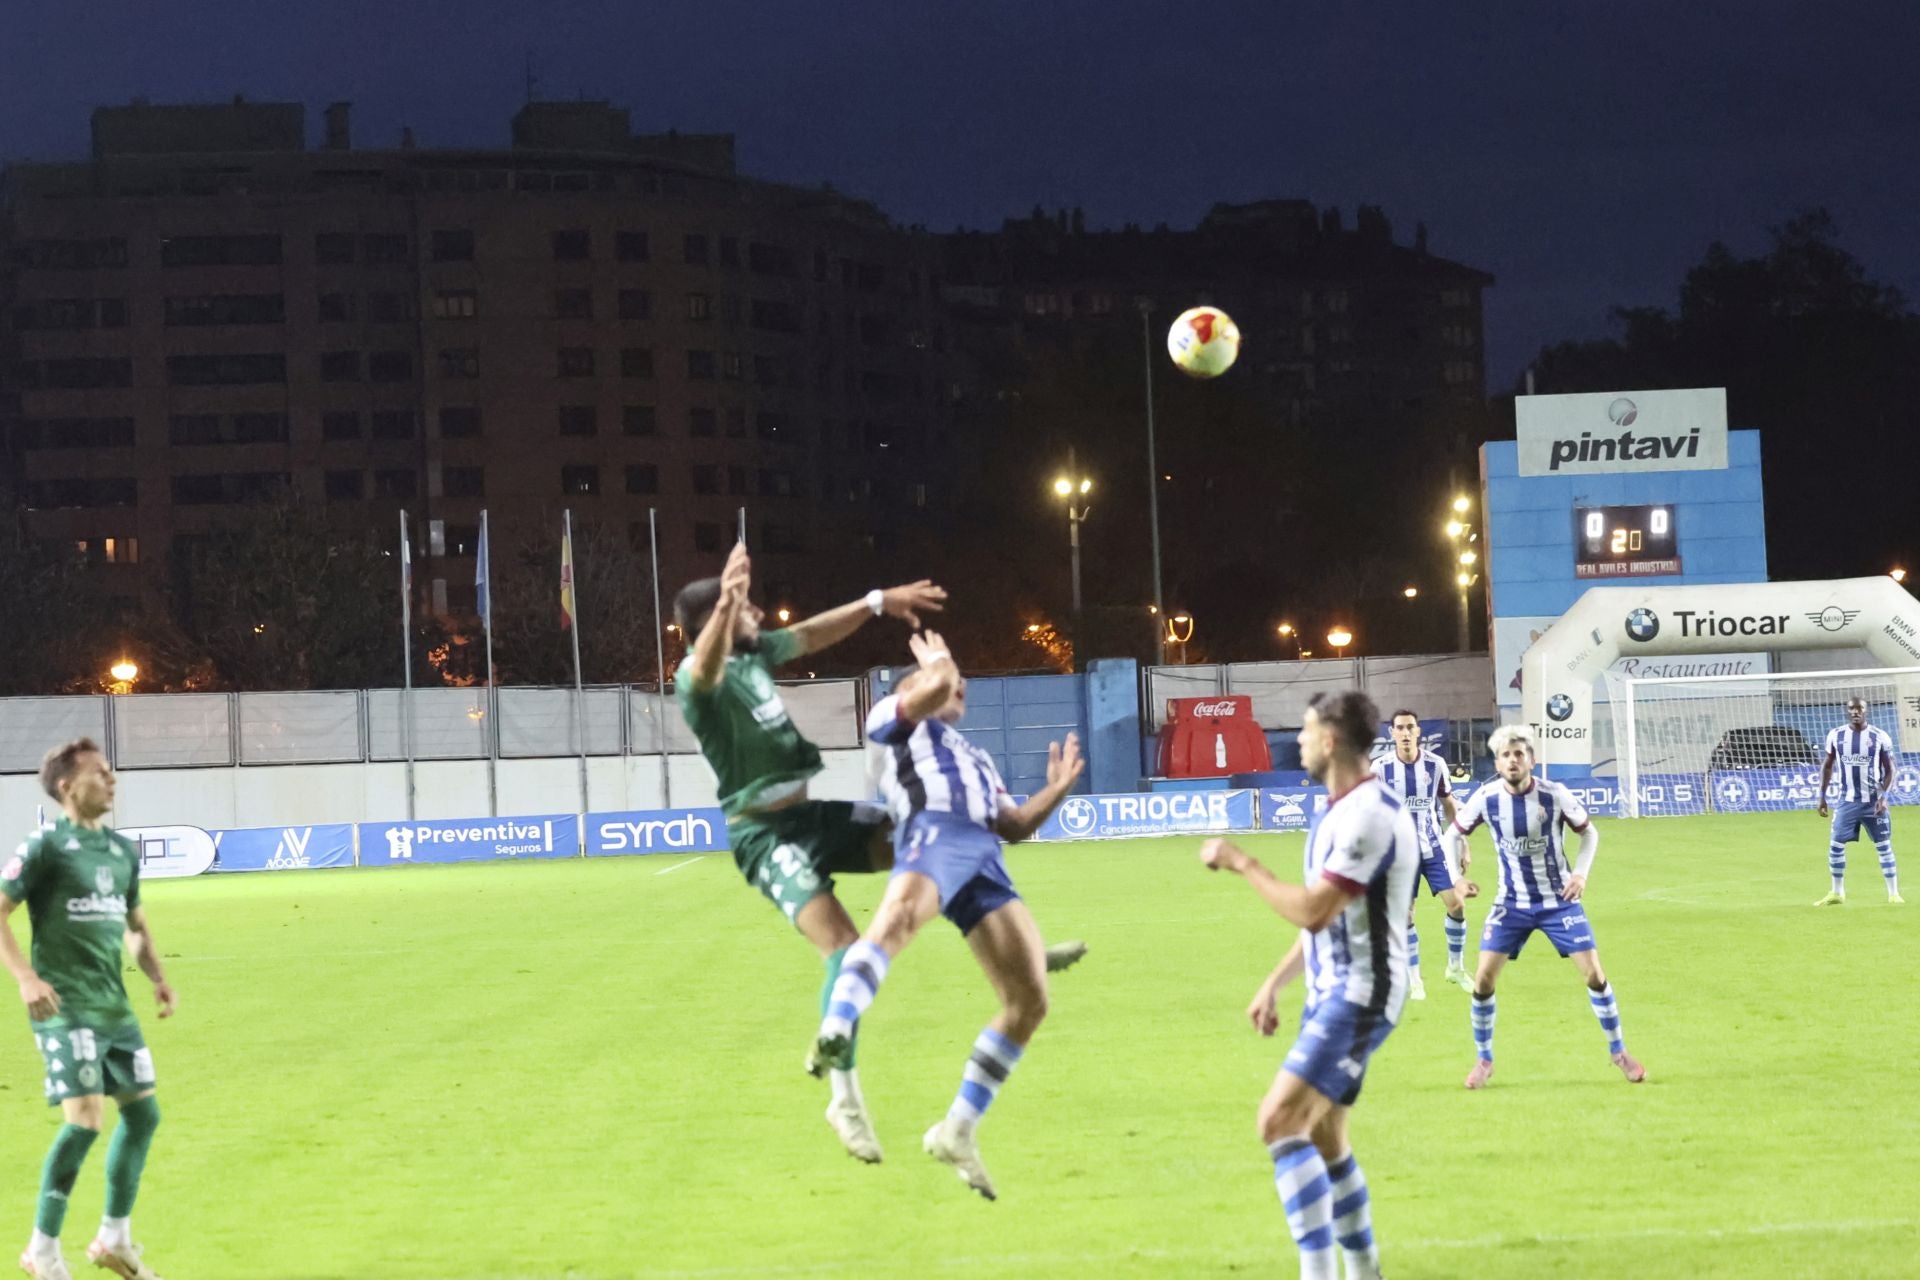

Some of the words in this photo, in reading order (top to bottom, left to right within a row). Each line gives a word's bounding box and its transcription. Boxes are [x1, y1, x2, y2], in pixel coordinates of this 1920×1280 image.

[1550, 428, 1700, 470] pintavi
[1586, 512, 1604, 538] 0
[1650, 509, 1668, 534] 0
[1576, 564, 1597, 575] REAL
[1673, 611, 1790, 637] Triocar
[1823, 615, 1843, 623] MINI
[1891, 615, 1918, 637] BMW
[1620, 658, 1752, 680] Restaurante
[1529, 723, 1587, 739] Triocar
[1906, 718, 1920, 729] TR
[1674, 785, 1692, 802] 5
[1757, 789, 1784, 801] DE
[1099, 794, 1228, 821] TRIOCAR
[417, 821, 541, 844] Preventiva
[496, 844, 541, 854] Seguros
